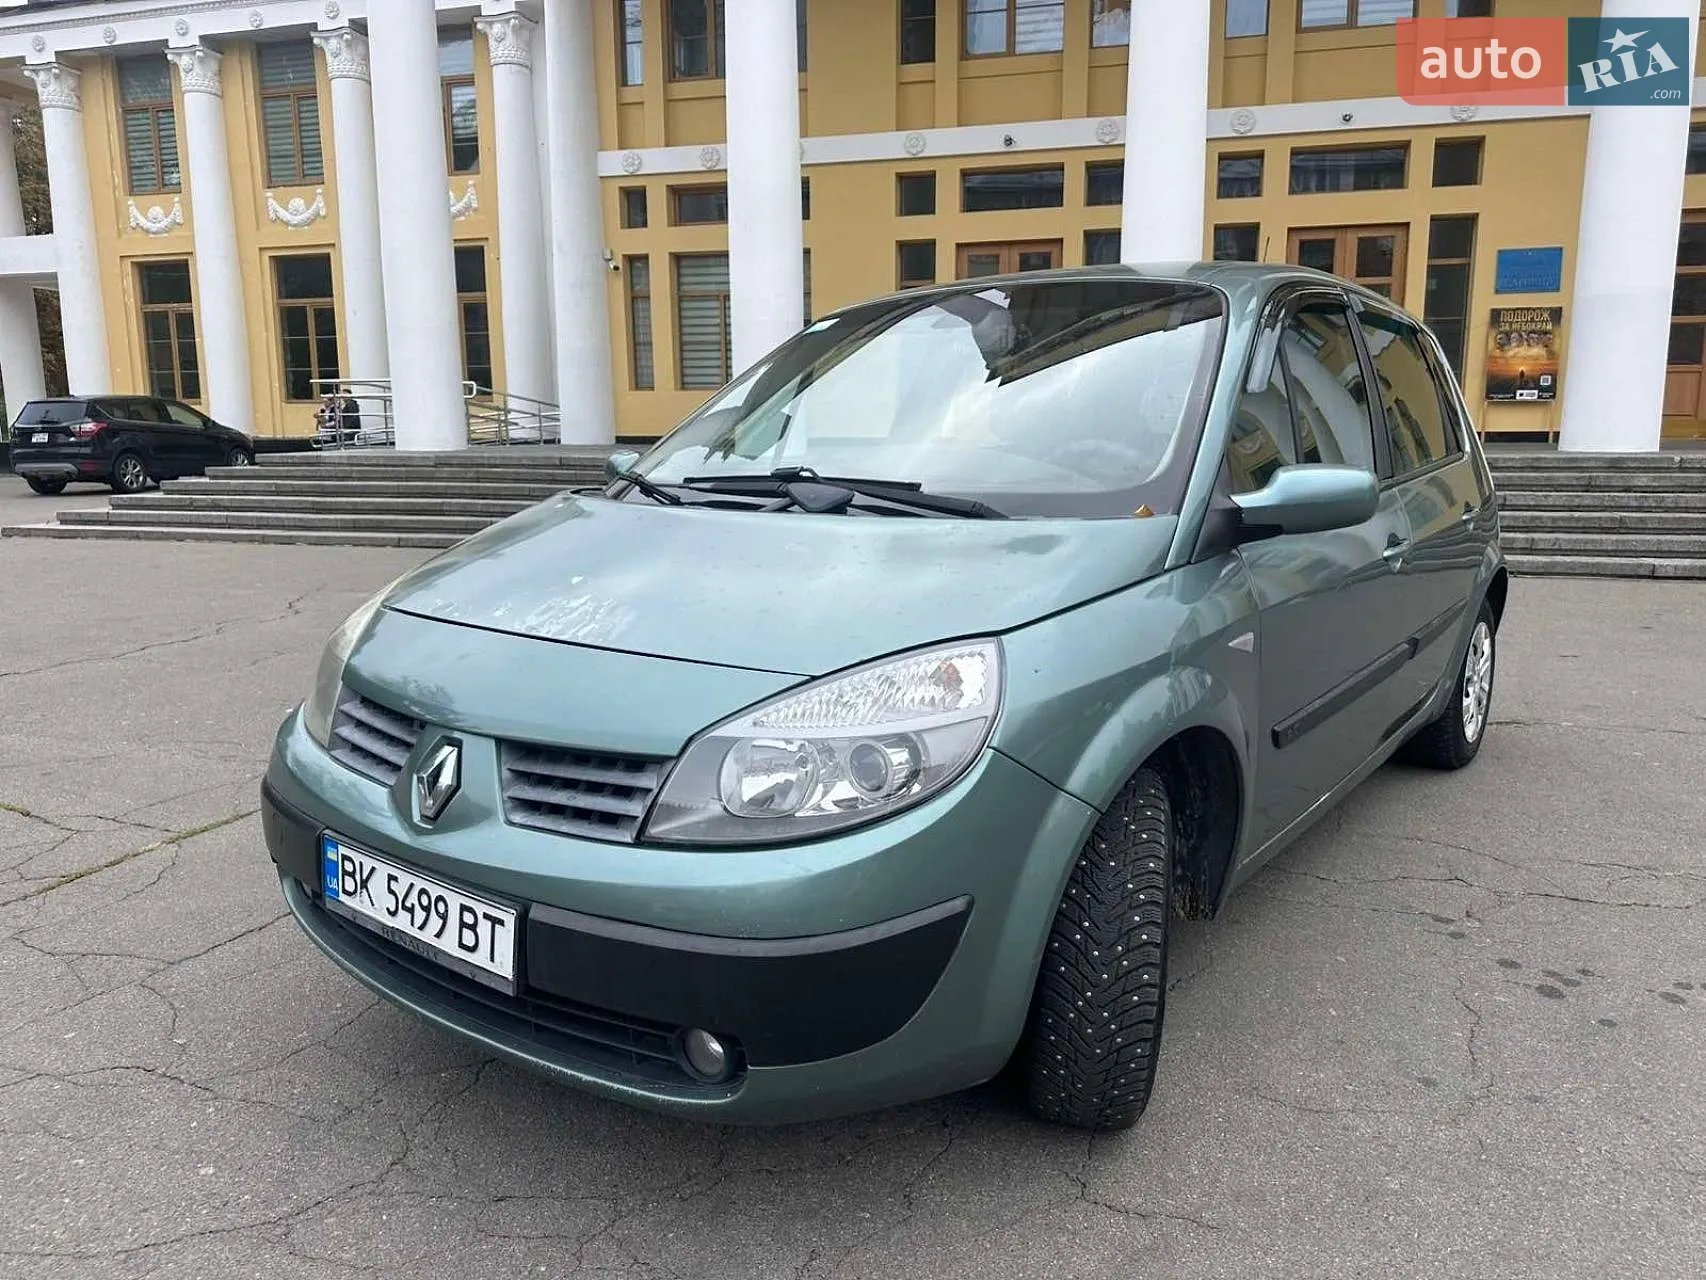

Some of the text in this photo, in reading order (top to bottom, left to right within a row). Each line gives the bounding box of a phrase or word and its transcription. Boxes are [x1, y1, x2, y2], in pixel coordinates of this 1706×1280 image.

[1500, 308, 1551, 322] ПОДОРОЖ
[1499, 322, 1510, 331] ЗА
[327, 874, 339, 891] UA
[341, 853, 505, 964] BK 5499 BT
